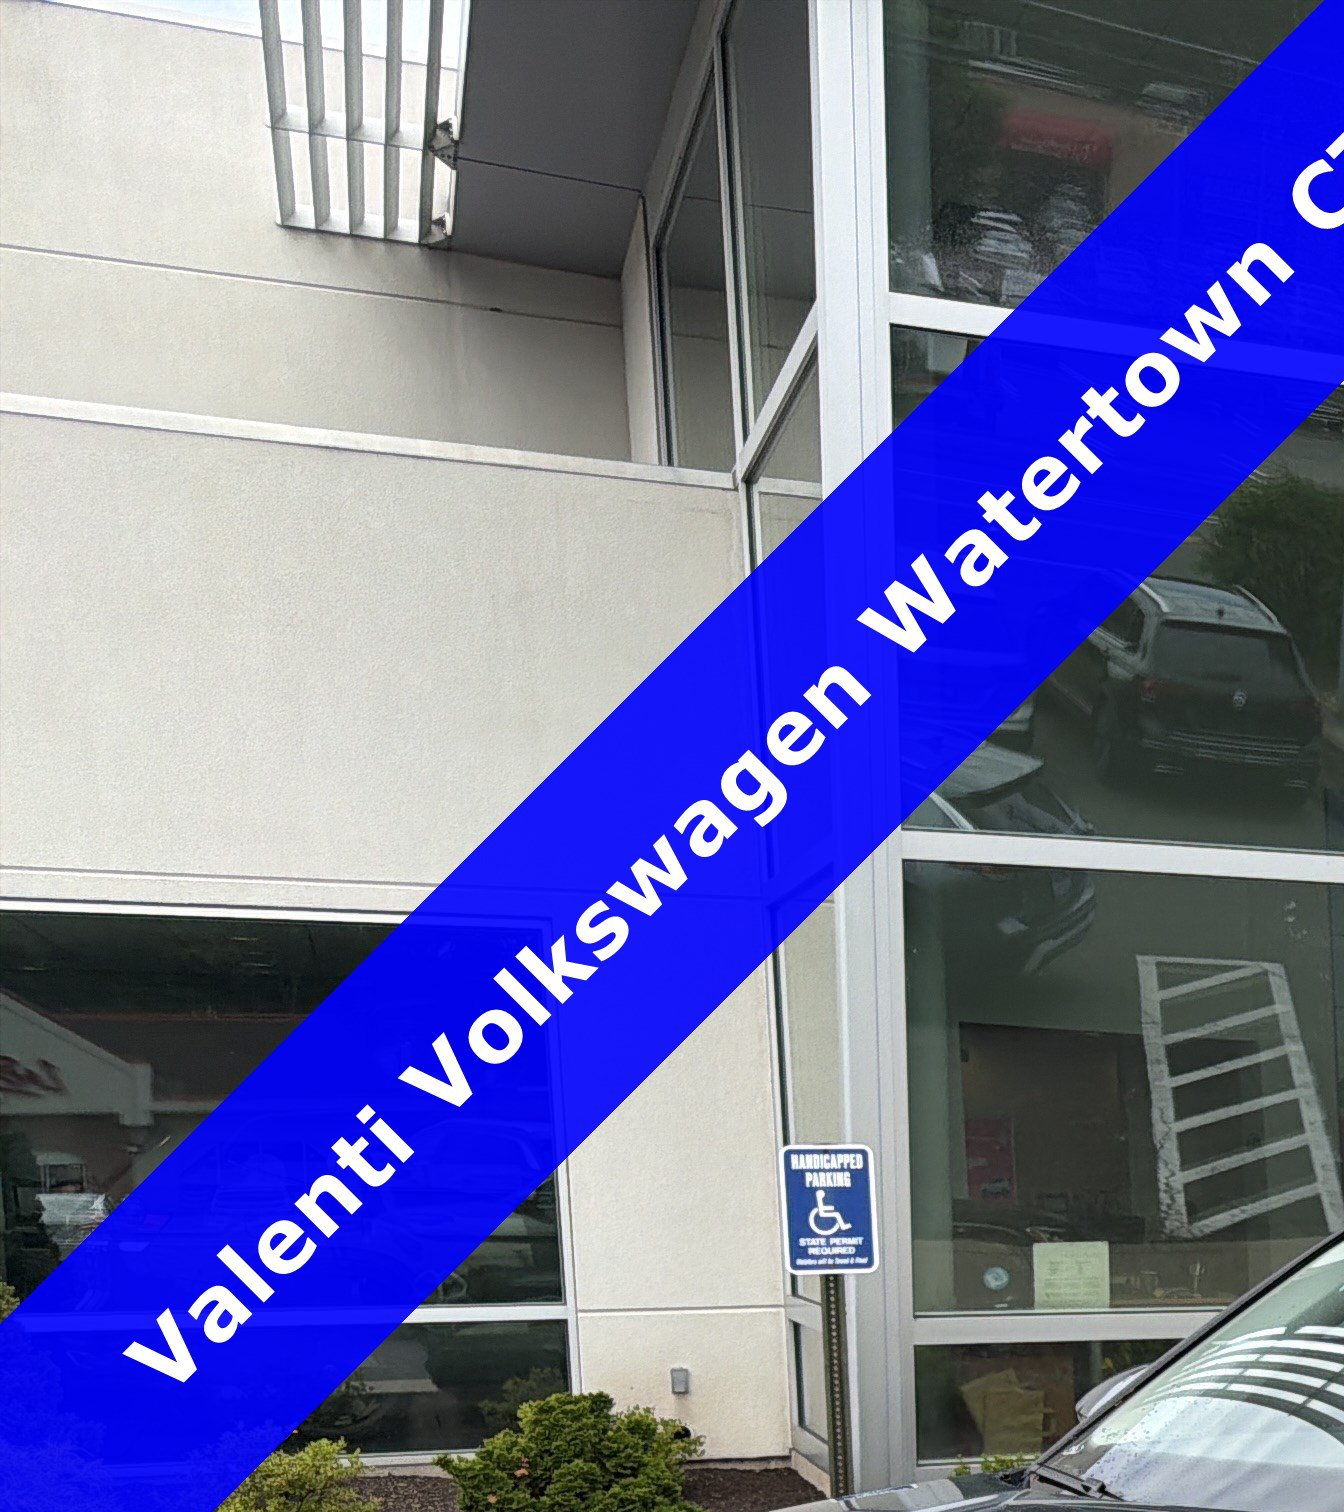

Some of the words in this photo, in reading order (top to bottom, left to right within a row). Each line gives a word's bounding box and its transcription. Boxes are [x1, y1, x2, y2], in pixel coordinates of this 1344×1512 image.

[791, 1153, 863, 1170] HANDICAPPED
[805, 1171, 852, 1188] PARKING
[799, 1237, 826, 1247] STATE
[830, 1237, 864, 1246] PERMIT
[808, 1246, 856, 1255] REQUIRED
